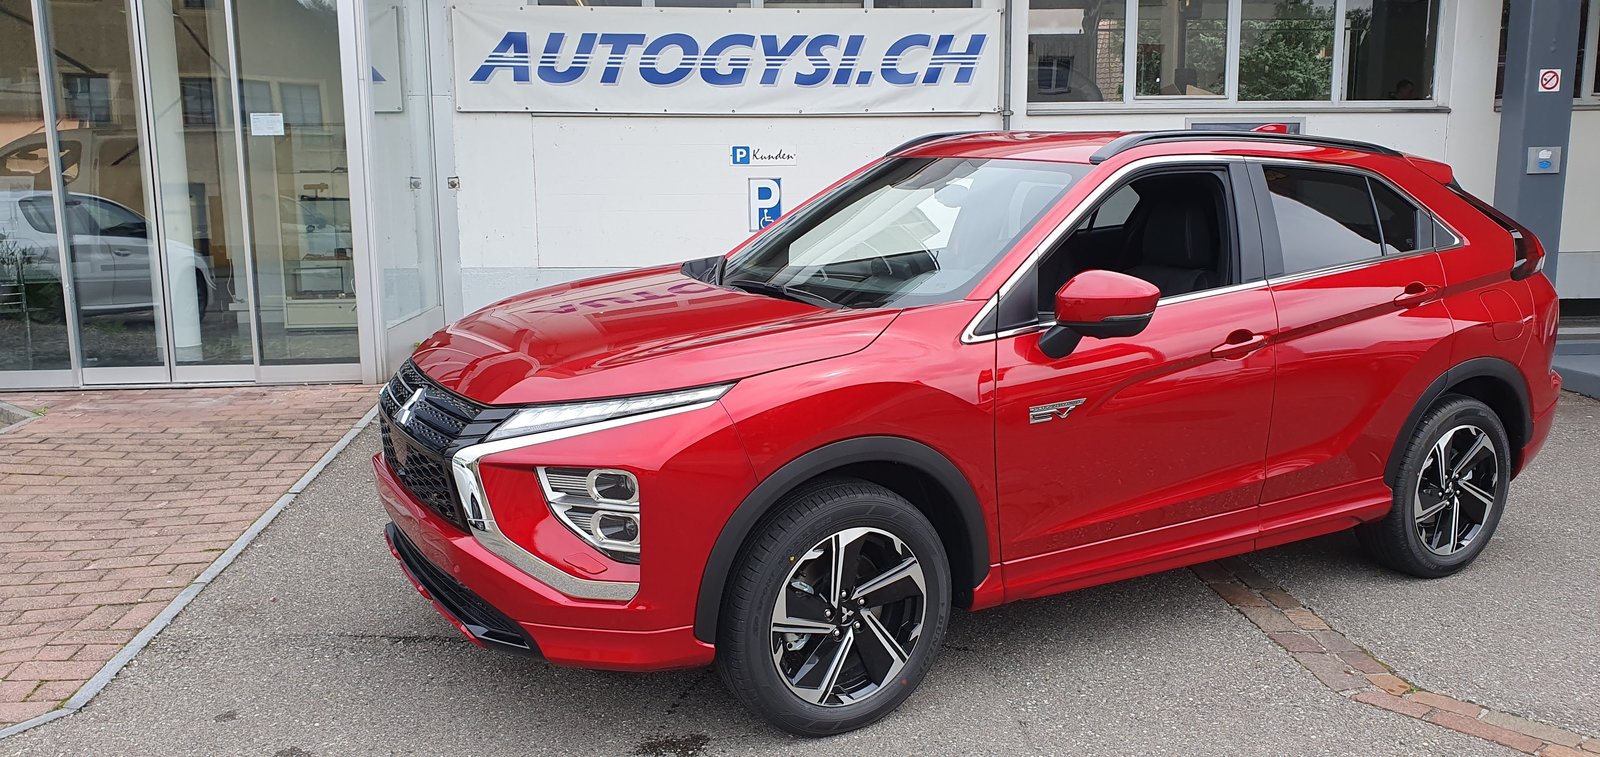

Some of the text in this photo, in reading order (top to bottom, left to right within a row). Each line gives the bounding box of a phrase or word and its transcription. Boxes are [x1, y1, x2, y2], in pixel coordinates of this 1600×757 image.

[470, 31, 988, 86] AUTOGYSI.CH
[736, 148, 794, 162] P Kunden
[749, 179, 780, 230] P
